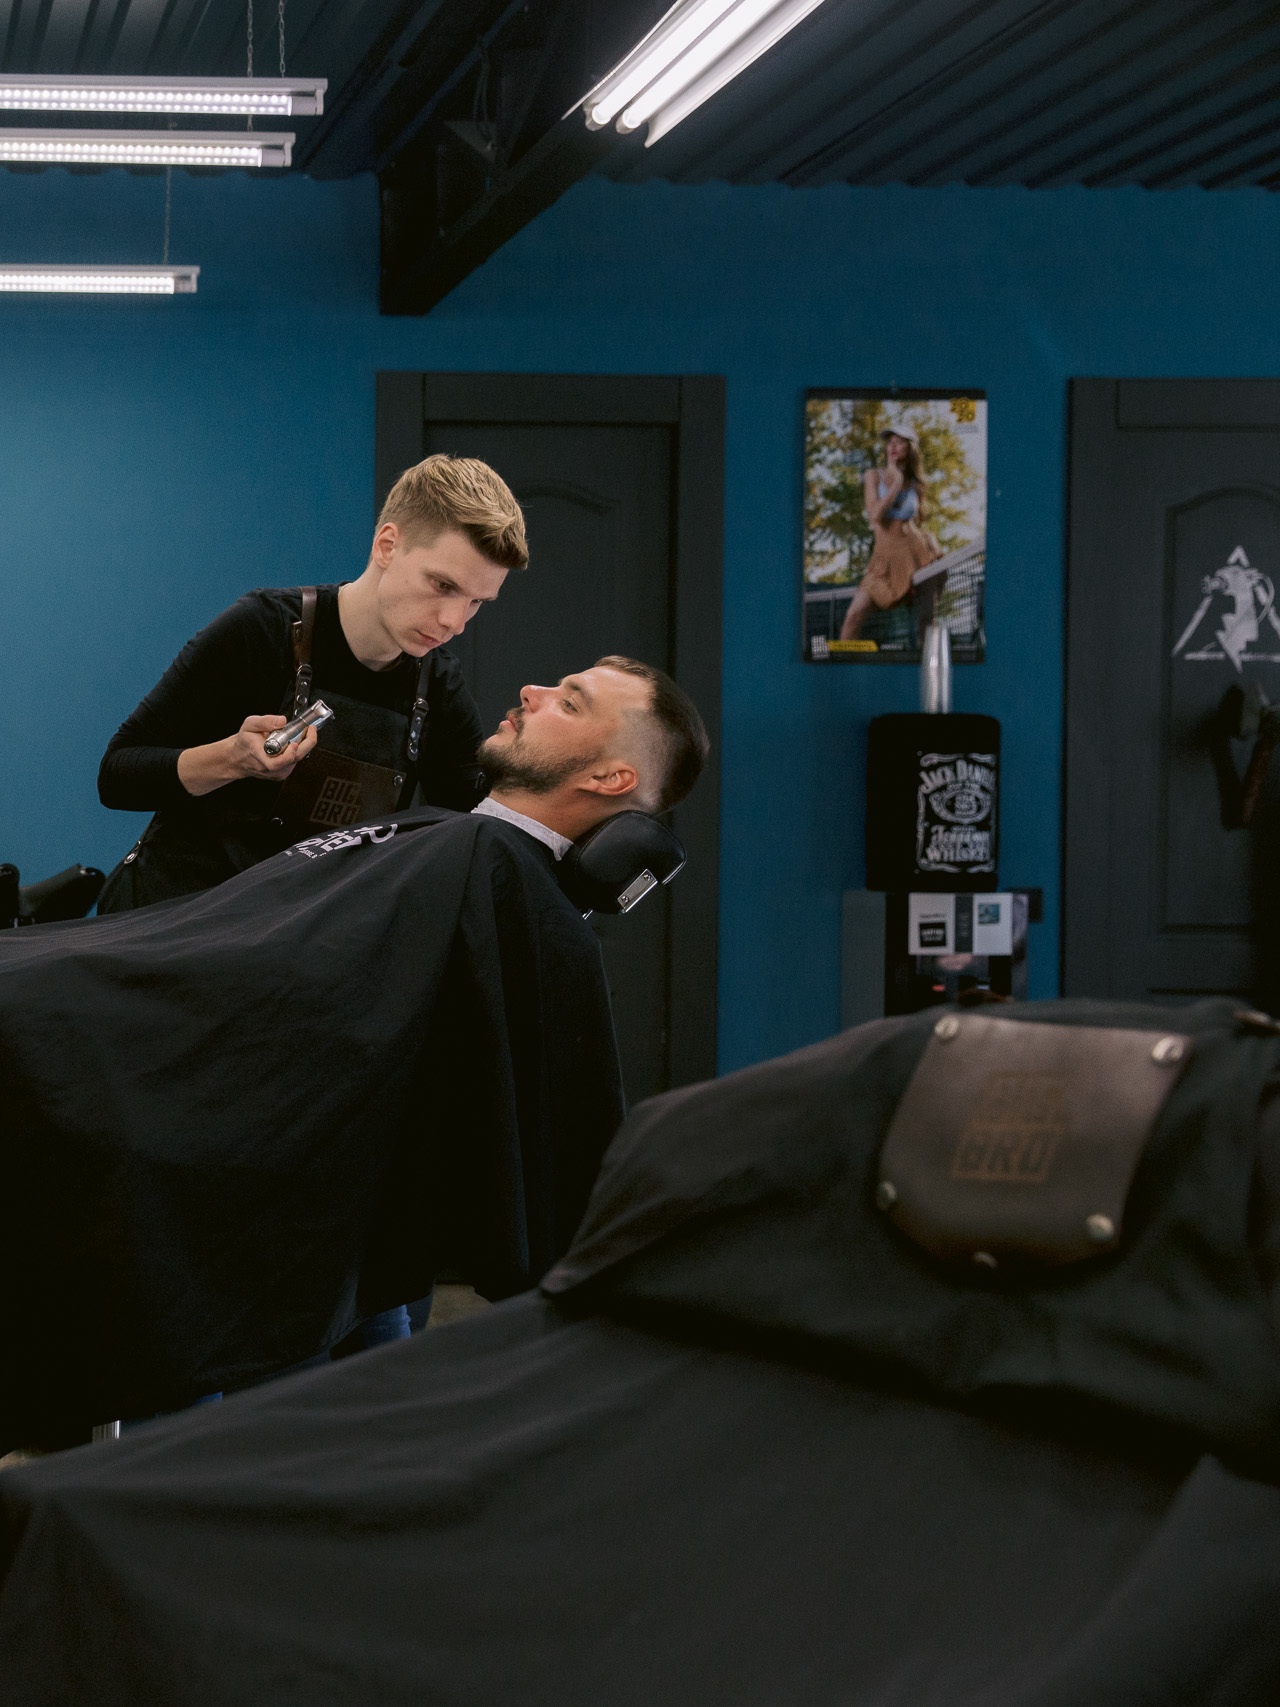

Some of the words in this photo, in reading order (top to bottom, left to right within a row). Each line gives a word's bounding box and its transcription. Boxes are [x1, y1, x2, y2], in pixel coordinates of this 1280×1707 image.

[322, 779, 360, 805] BIG
[919, 765, 955, 794] JACK
[313, 801, 358, 826] BRO
